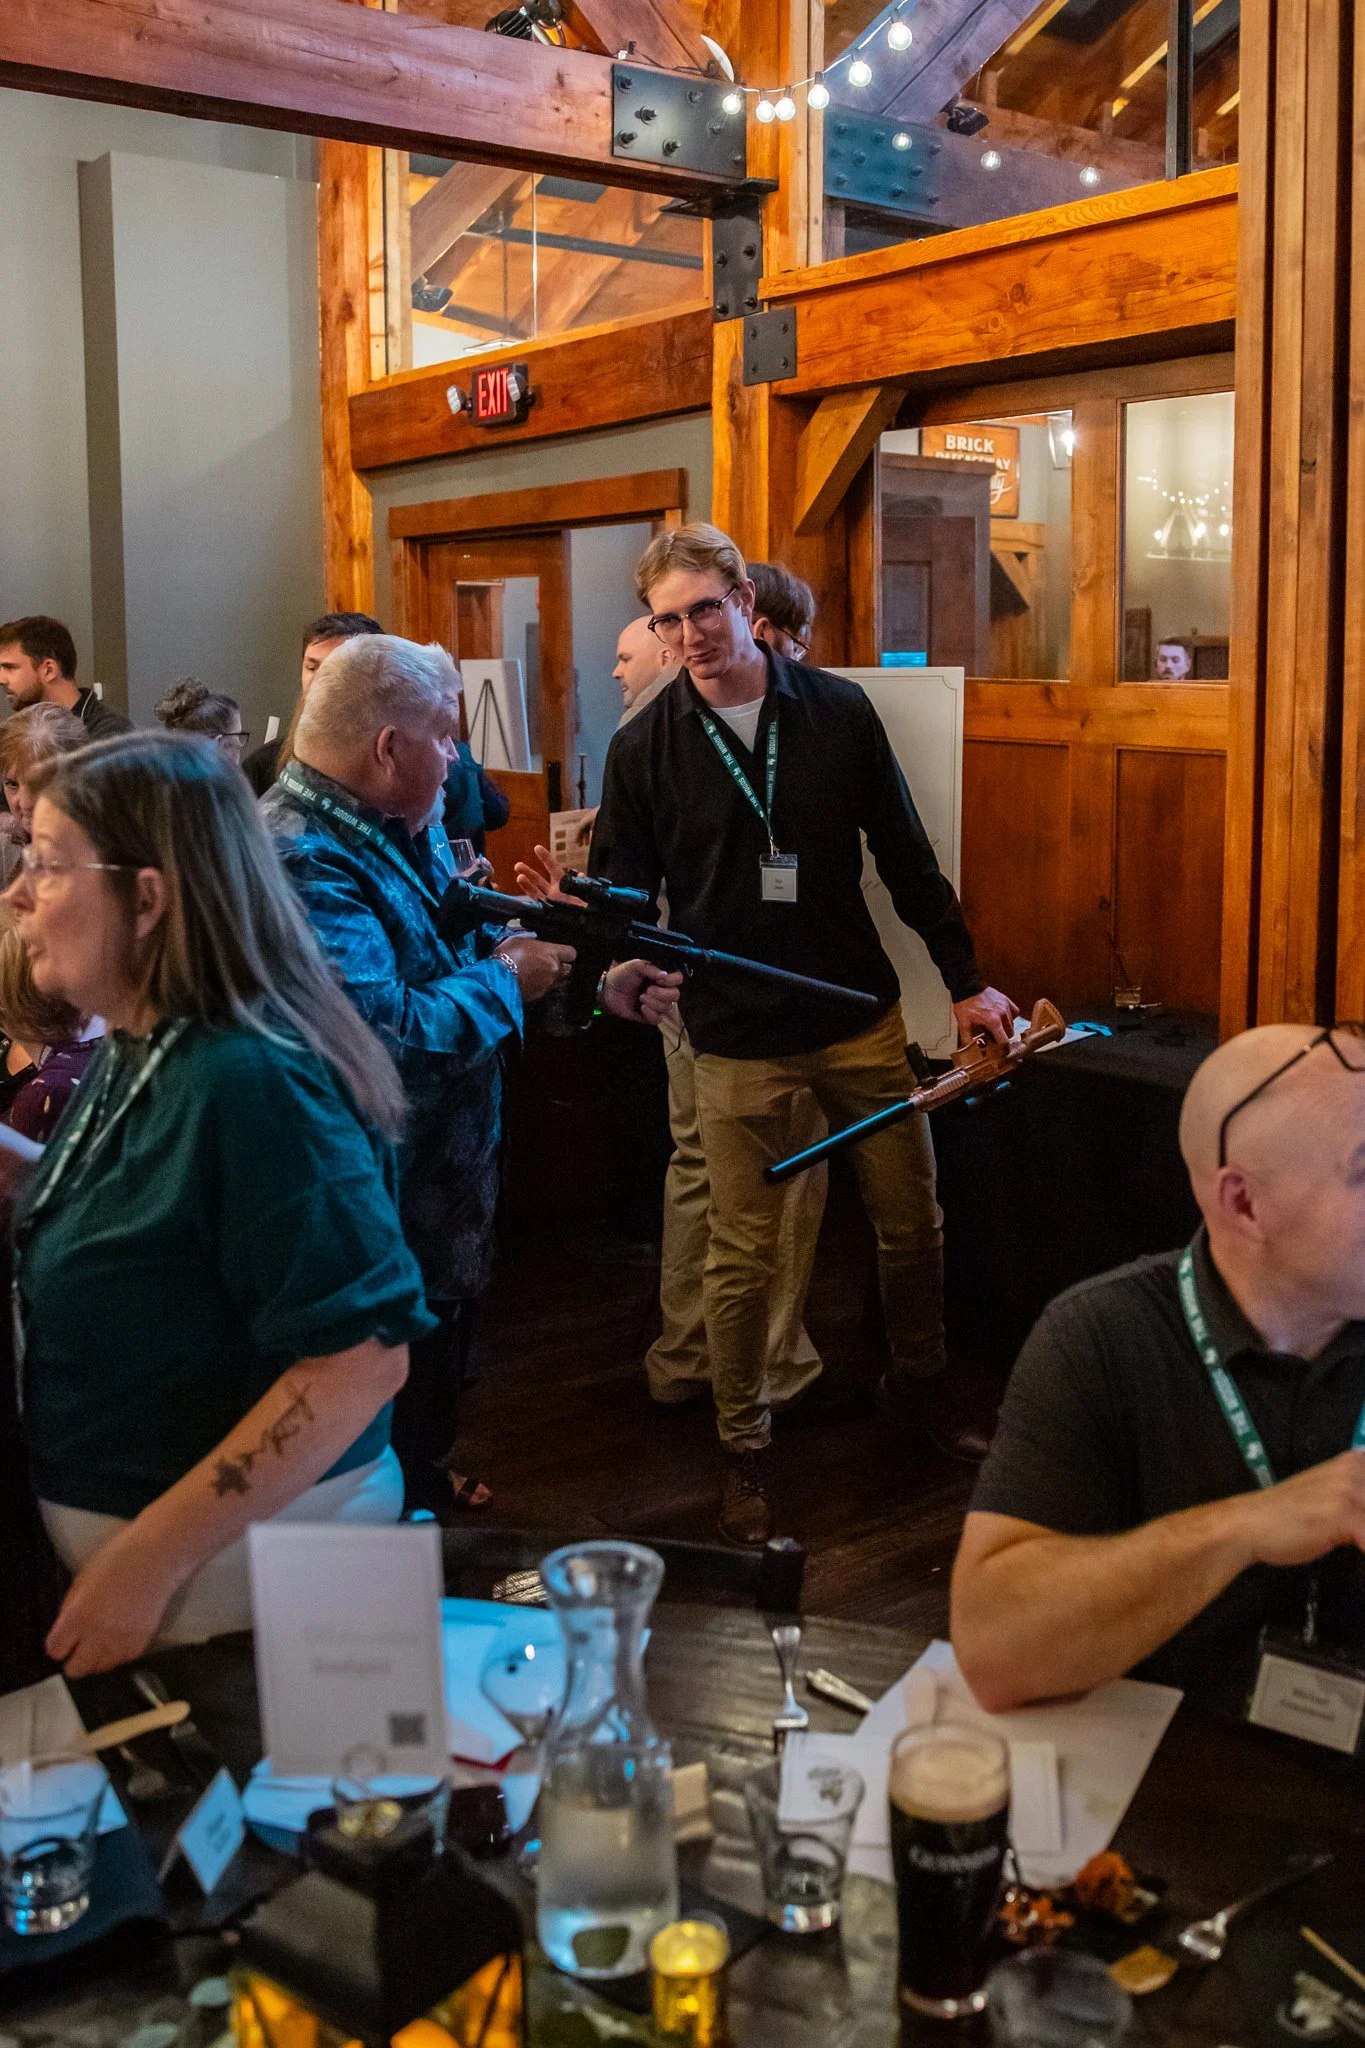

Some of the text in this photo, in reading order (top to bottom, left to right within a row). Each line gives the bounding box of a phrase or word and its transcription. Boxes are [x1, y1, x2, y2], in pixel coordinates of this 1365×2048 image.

[477, 369, 509, 416] EXIT
[945, 434, 994, 453] BRICK
[723, 753, 734, 766] THE
[302, 787, 317, 801] THE
[738, 777, 753, 797] WOODS
[333, 806, 372, 836] THE WOODS
